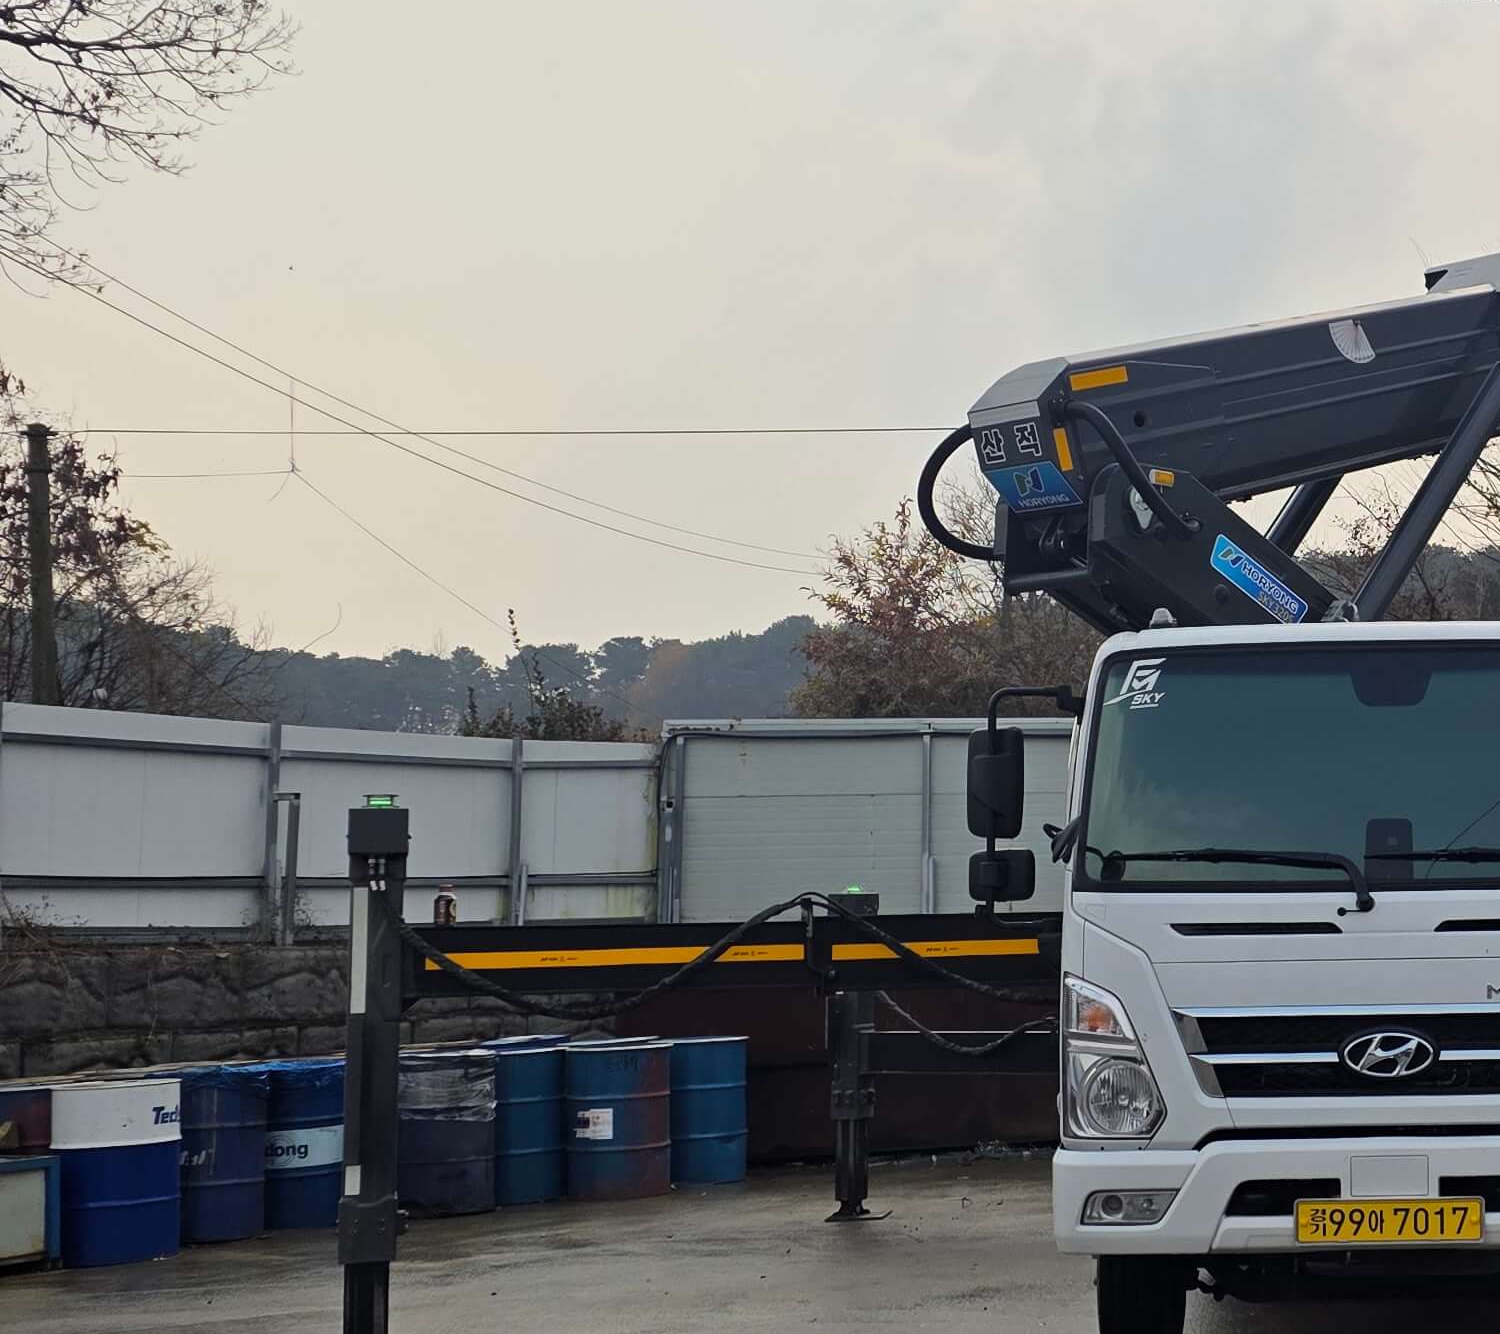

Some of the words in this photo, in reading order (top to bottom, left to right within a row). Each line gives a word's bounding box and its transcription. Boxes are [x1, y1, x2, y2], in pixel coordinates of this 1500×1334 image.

[1018, 493, 1069, 508] HORYONG
[1240, 560, 1301, 615] HORYONG
[1131, 692, 1166, 704] SKY
[152, 1105, 180, 1125] Ted
[1392, 1207, 1469, 1235] 7017
